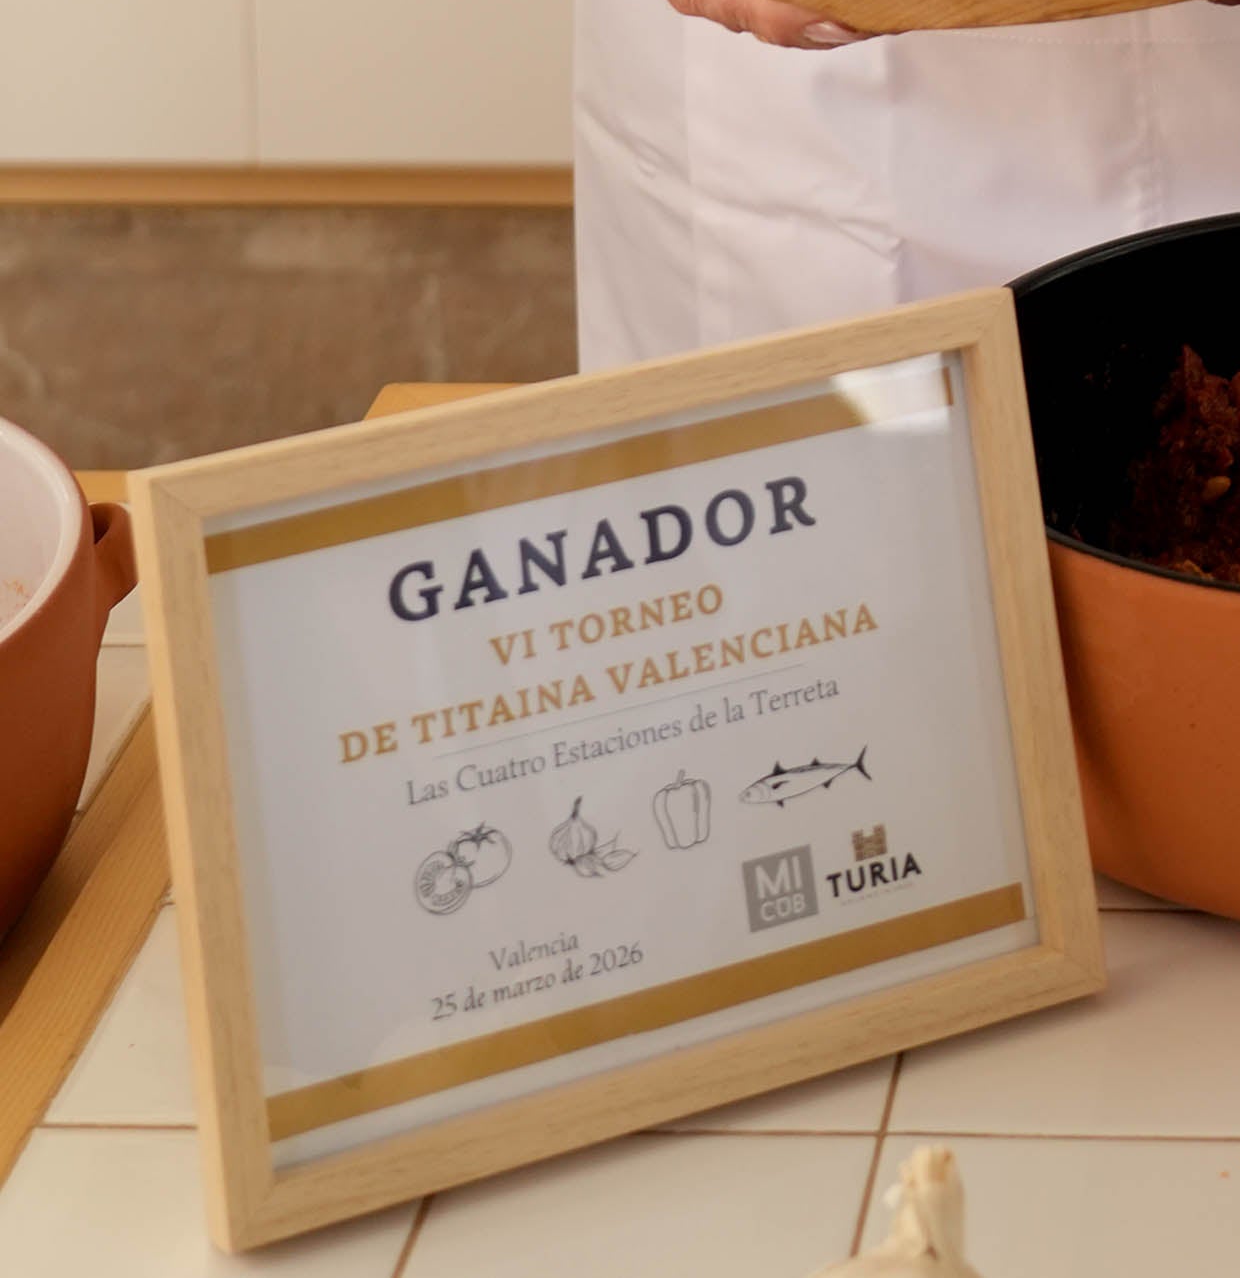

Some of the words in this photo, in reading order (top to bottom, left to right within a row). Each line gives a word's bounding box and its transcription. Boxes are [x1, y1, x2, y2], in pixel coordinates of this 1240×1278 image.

[388, 476, 817, 623] GANADOR
[489, 629, 536, 666] VI
[549, 583, 723, 652] TORNEO
[339, 722, 398, 764] DE
[411, 675, 595, 744] TITAINA
[606, 602, 879, 695] VALENCIANA
[405, 780, 449, 807] Las
[455, 755, 547, 792] Cuatro
[553, 718, 683, 769] Estaciones
[689, 704, 718, 734] de
[724, 697, 745, 724] la
[749, 679, 840, 717] Terreta
[755, 855, 803, 899] MI
[826, 852, 922, 898] TURIA
[431, 992, 458, 1021] 25
[463, 986, 485, 1012] de
[493, 972, 556, 1004] marzo
[562, 958, 584, 984] de
[589, 940, 644, 977] 2026
[488, 931, 579, 971] Valencia
